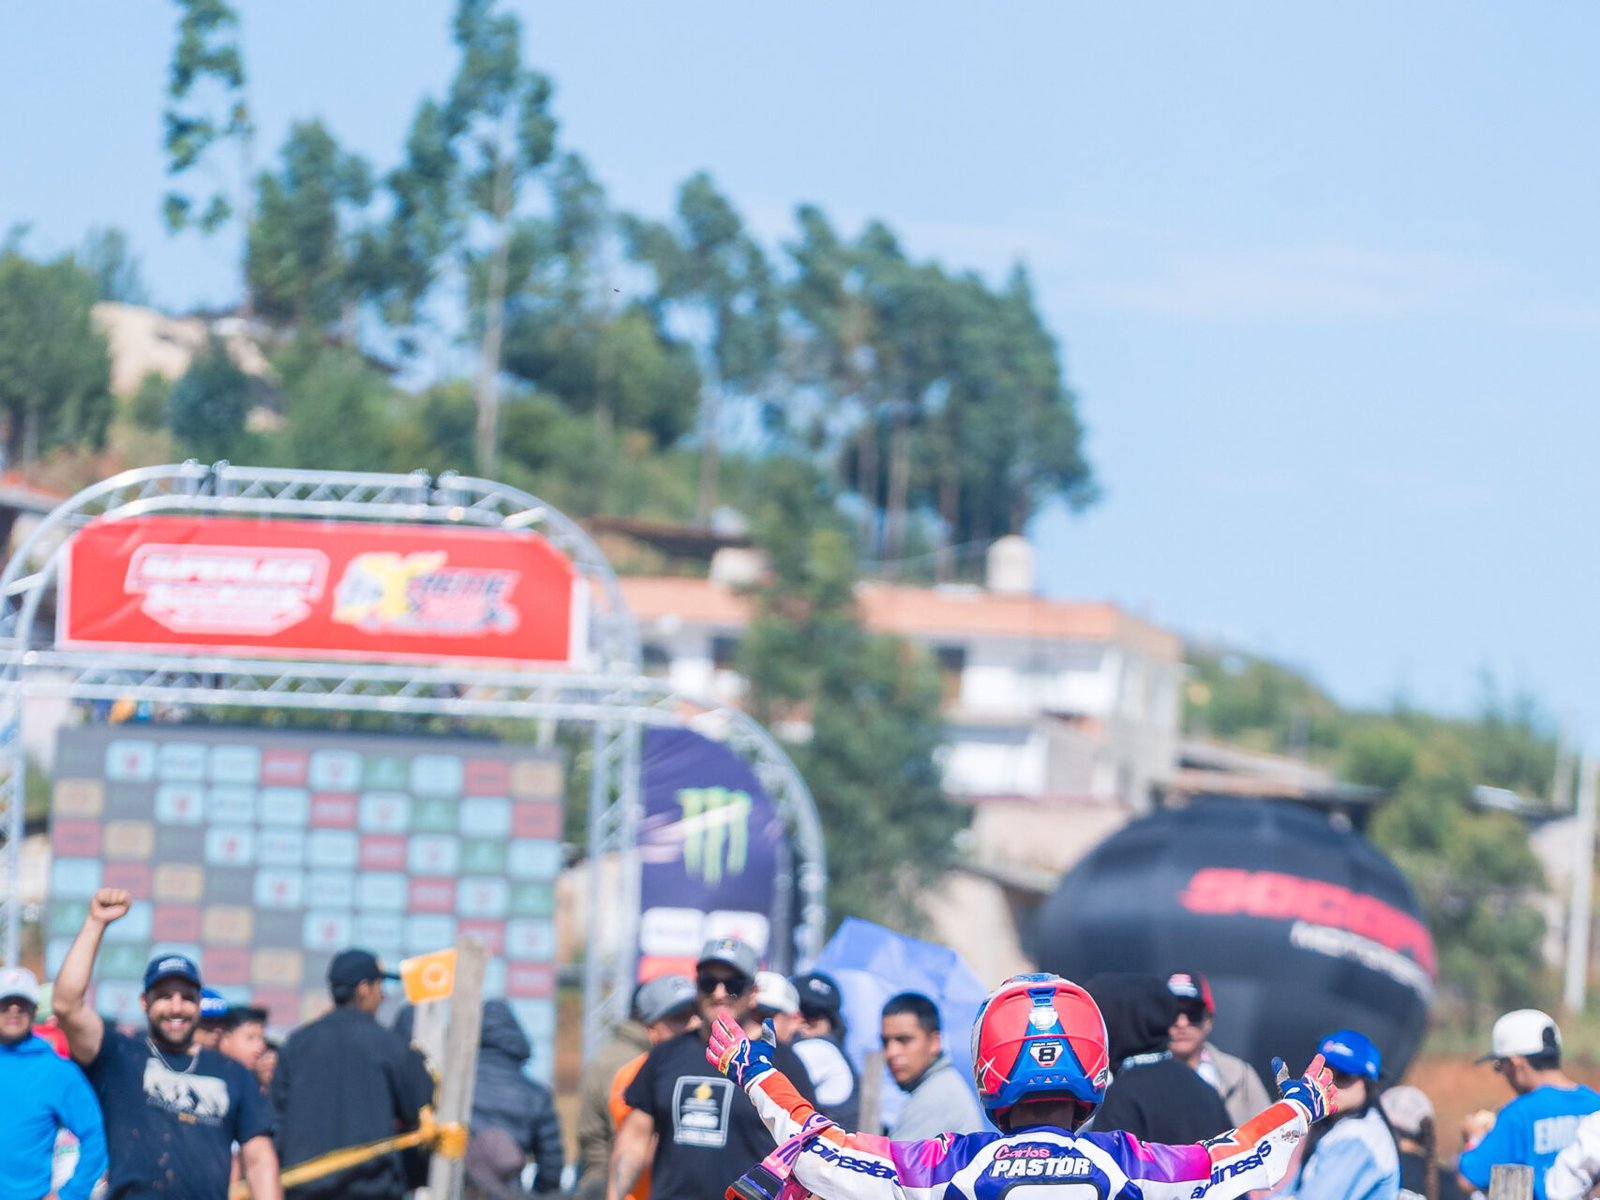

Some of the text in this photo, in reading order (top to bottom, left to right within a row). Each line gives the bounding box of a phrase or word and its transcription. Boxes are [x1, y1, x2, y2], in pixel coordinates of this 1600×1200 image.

[1039, 1047, 1056, 1062] 8
[994, 1145, 1050, 1160] Carlos
[990, 1158, 1091, 1177] PASTOR
